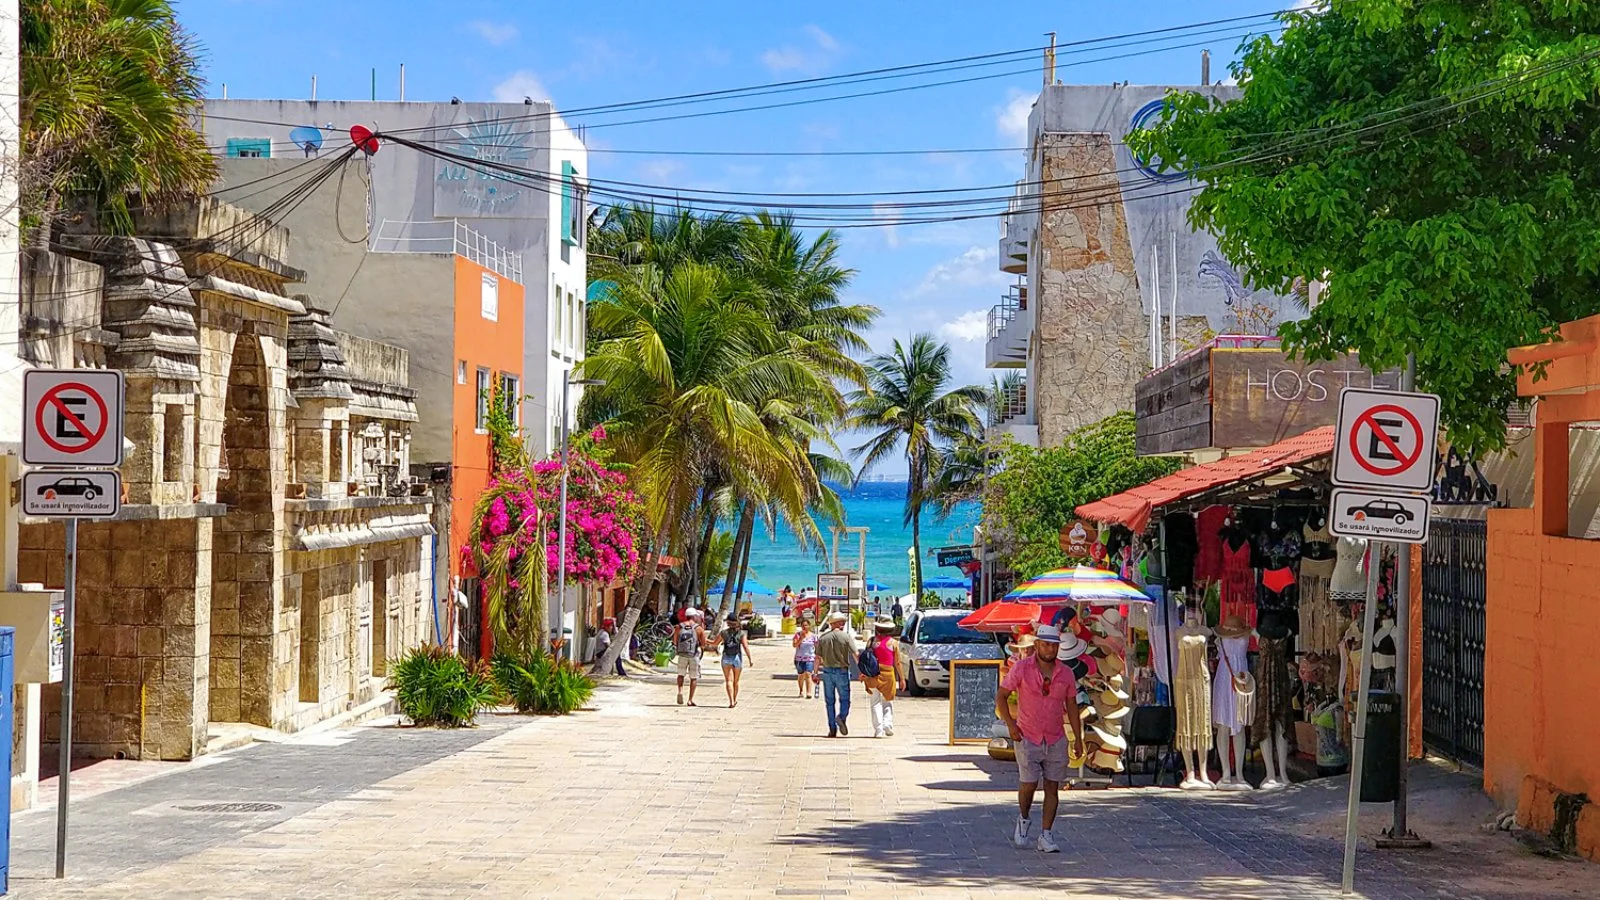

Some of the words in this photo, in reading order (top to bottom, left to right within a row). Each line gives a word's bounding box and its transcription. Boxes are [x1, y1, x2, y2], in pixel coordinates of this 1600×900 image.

[55, 397, 88, 438] E
[1369, 418, 1404, 461] E
[1349, 523, 1370, 531] usará
[1371, 525, 1420, 535] inmovilizador
